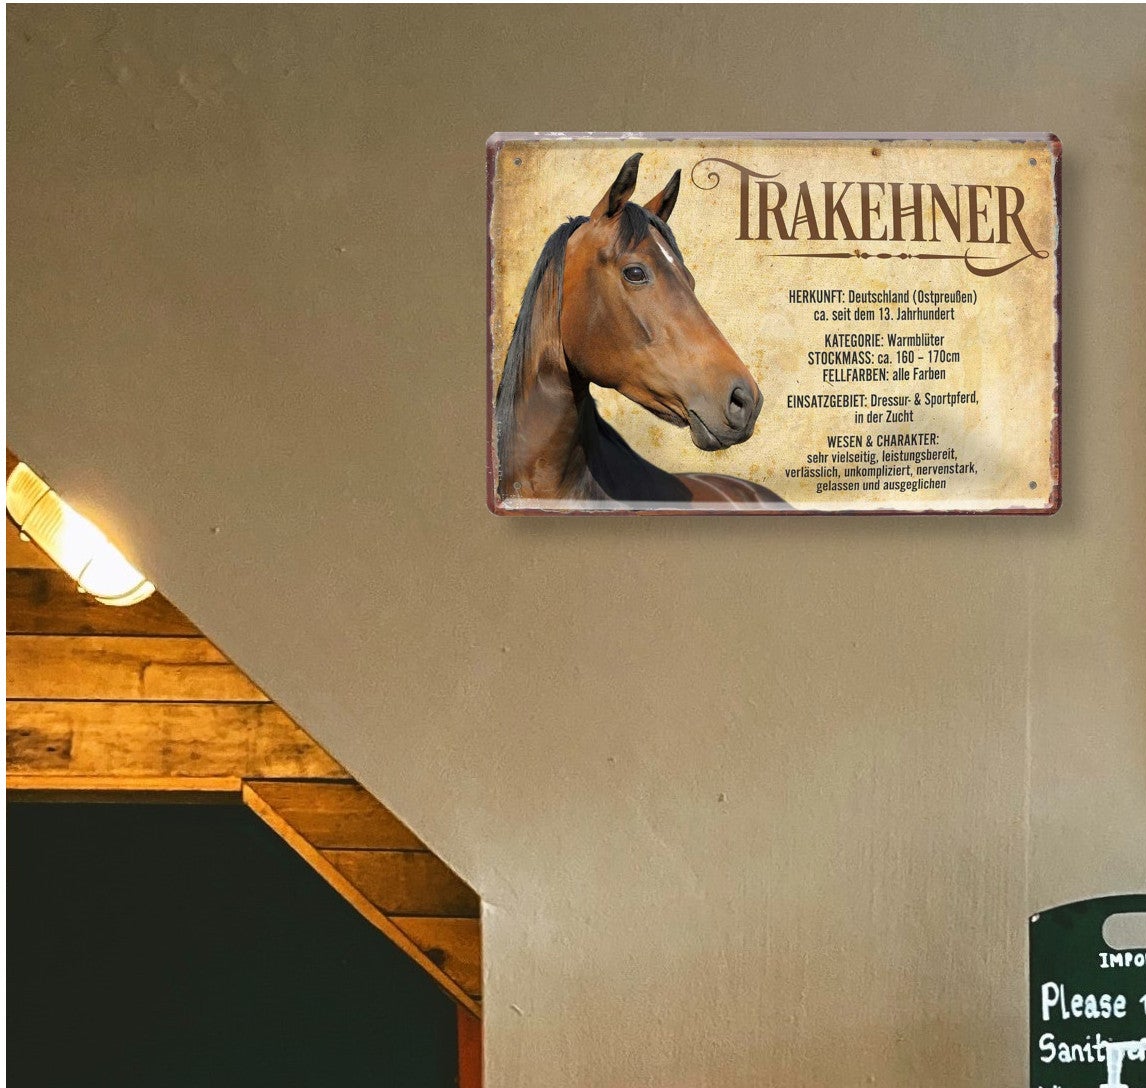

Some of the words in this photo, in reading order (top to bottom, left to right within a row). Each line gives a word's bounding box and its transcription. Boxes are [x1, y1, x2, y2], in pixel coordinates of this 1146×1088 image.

[691, 158, 1050, 277] TRAKEHNER
[788, 289, 845, 304] HERKUNFT:
[848, 289, 910, 304] Deutschland
[912, 289, 978, 306] (Ostpreußen)
[813, 309, 829, 321] ca.
[832, 308, 852, 321] seit
[854, 307, 875, 321] dem
[878, 307, 894, 321] 13.
[896, 306, 955, 321] Jahrhundert
[824, 333, 884, 348] KATEGORIE:
[887, 333, 945, 347] Warmblüter
[807, 351, 875, 365] STOCKMASS:
[877, 354, 892, 365] ca.
[896, 350, 915, 364] 160
[928, 349, 960, 363] 170cm
[822, 368, 890, 382] FELLFARBEN:
[892, 367, 910, 381] alle
[913, 367, 946, 380] Farben
[787, 394, 867, 408] EINSATZGEBIET:
[870, 394, 911, 407] Dressur-
[914, 392, 922, 406] &
[924, 391, 979, 408] Sportpferd,
[854, 411, 864, 424] in
[866, 411, 883, 423] der
[885, 410, 914, 423] Zucht
[827, 435, 862, 448] WESEN
[866, 434, 873, 447] &
[876, 433, 940, 447] CHARAKTER:
[807, 452, 829, 463] sehr
[831, 451, 879, 465] vielseitig,
[882, 448, 958, 464] leistungsbereit,
[785, 466, 841, 479] verlässlich,
[844, 464, 913, 479] unkompliziert,
[916, 462, 978, 476] nervenstark,
[816, 480, 860, 494] gelassen
[862, 479, 880, 491] und
[883, 478, 946, 493] ausgeglichen
[1041, 981, 1127, 1021] Please
